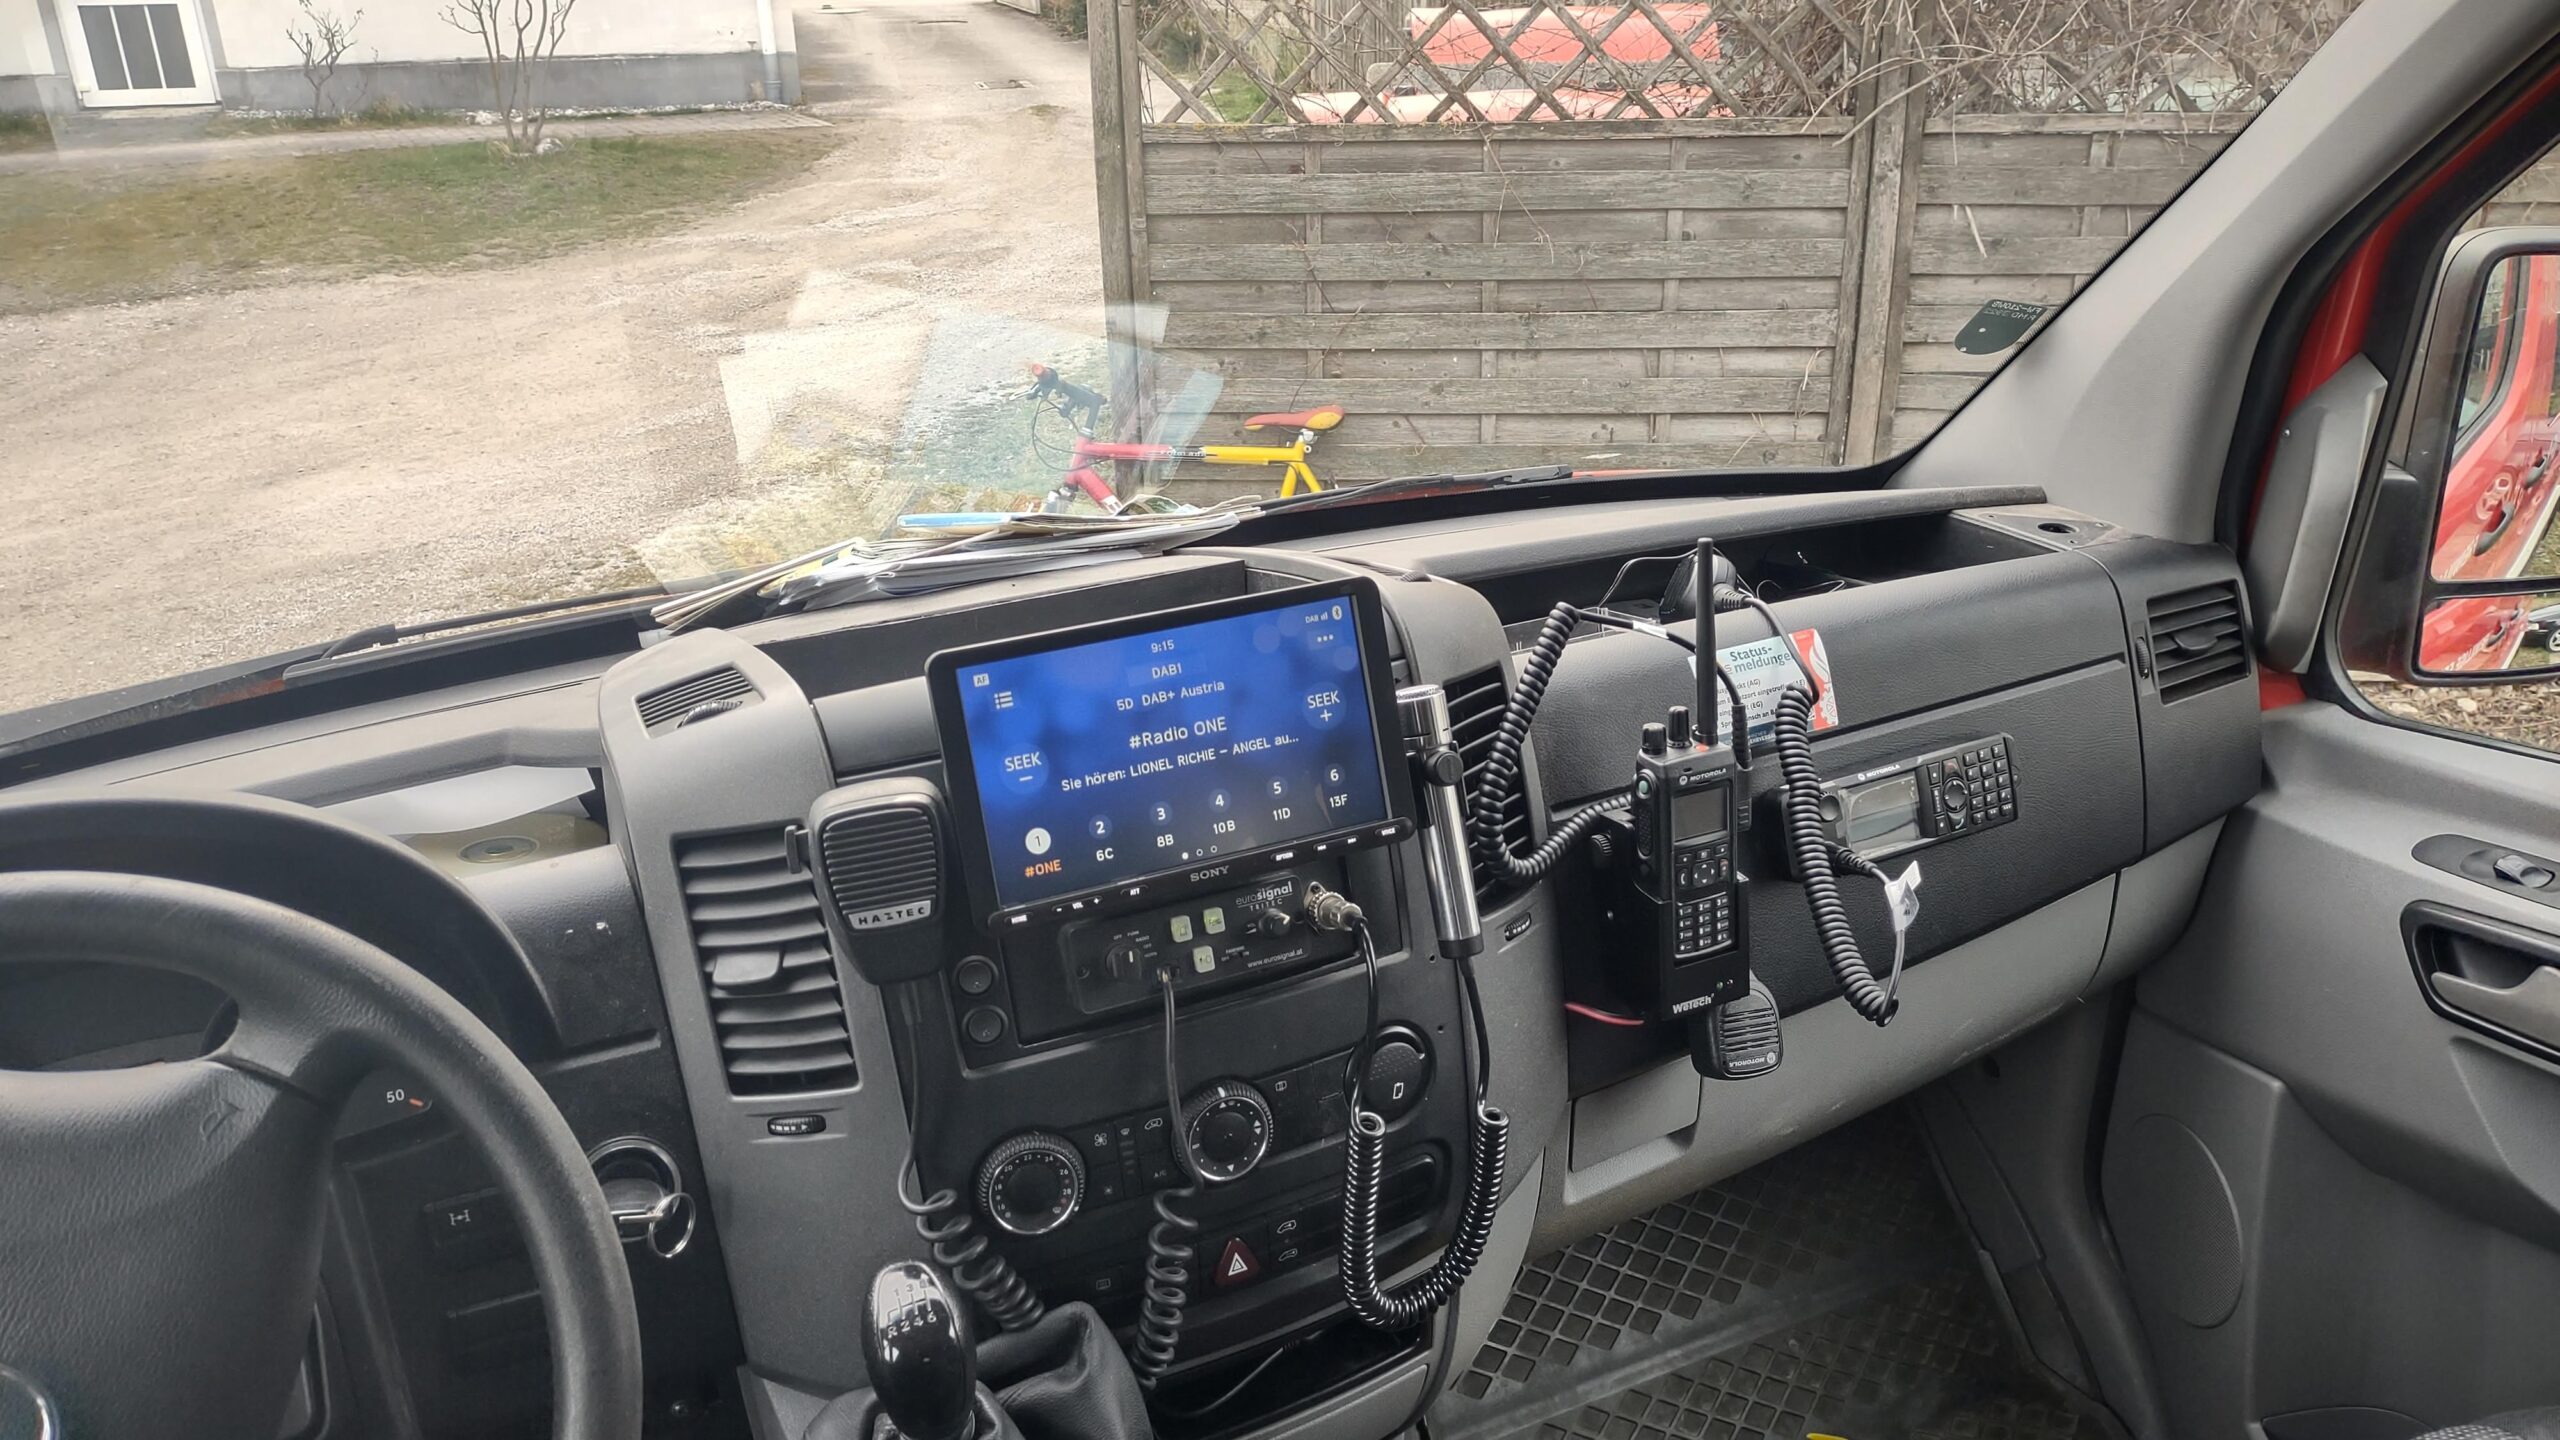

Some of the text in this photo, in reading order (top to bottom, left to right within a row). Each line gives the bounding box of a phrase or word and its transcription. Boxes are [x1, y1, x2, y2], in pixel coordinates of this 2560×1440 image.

[1305, 615, 1320, 624] DAB
[1151, 639, 1175, 653] 9:15
[1729, 645, 1773, 663] Status-
[1734, 651, 1793, 674] meldunge
[1151, 662, 1182, 679] DAB1
[1116, 680, 1225, 711] 5D DAB+ Austria
[1307, 690, 1340, 709] SEEK
[1129, 716, 1227, 749] #Radio ONE
[1004, 751, 1042, 772] SEEK
[1061, 777, 1082, 791] Sie
[1085, 768, 1126, 787] hören:
[1130, 757, 1174, 777] LIONEL
[1177, 748, 1216, 767] RICHIE
[1232, 736, 1271, 755] ANGEL
[1329, 768, 1340, 782] 6
[1689, 767, 1727, 782] MOTOROLA
[1866, 764, 1901, 777] MOTOROLA
[1273, 781, 1282, 794] 5
[1215, 794, 1225, 807] 4
[1329, 794, 1348, 808] 13F
[1156, 807, 1167, 821] 3
[1273, 807, 1291, 822] 11D
[1095, 820, 1106, 834] 2
[1213, 819, 1236, 835] 10B
[1034, 834, 1042, 848] 1
[1156, 834, 1175, 848] 8B
[1095, 848, 1114, 862] 6C
[1024, 859, 1063, 878] #ONE
[1190, 865, 1229, 882] SONY
[1236, 880, 1293, 905] eurosignal
[1250, 897, 1283, 912] TRITEC
[858, 906, 925, 926] HAZTEC
[1247, 948, 1303, 969] www.eurosignal.at
[1728, 1057, 1766, 1068] MOTOROLA
[386, 1088, 405, 1104] 50
[1059, 1168, 1069, 1176] 26
[1062, 1187, 1072, 1196] 28
[905, 1283, 914, 1293] 3
[887, 1311, 937, 1339] R 2 4 6
